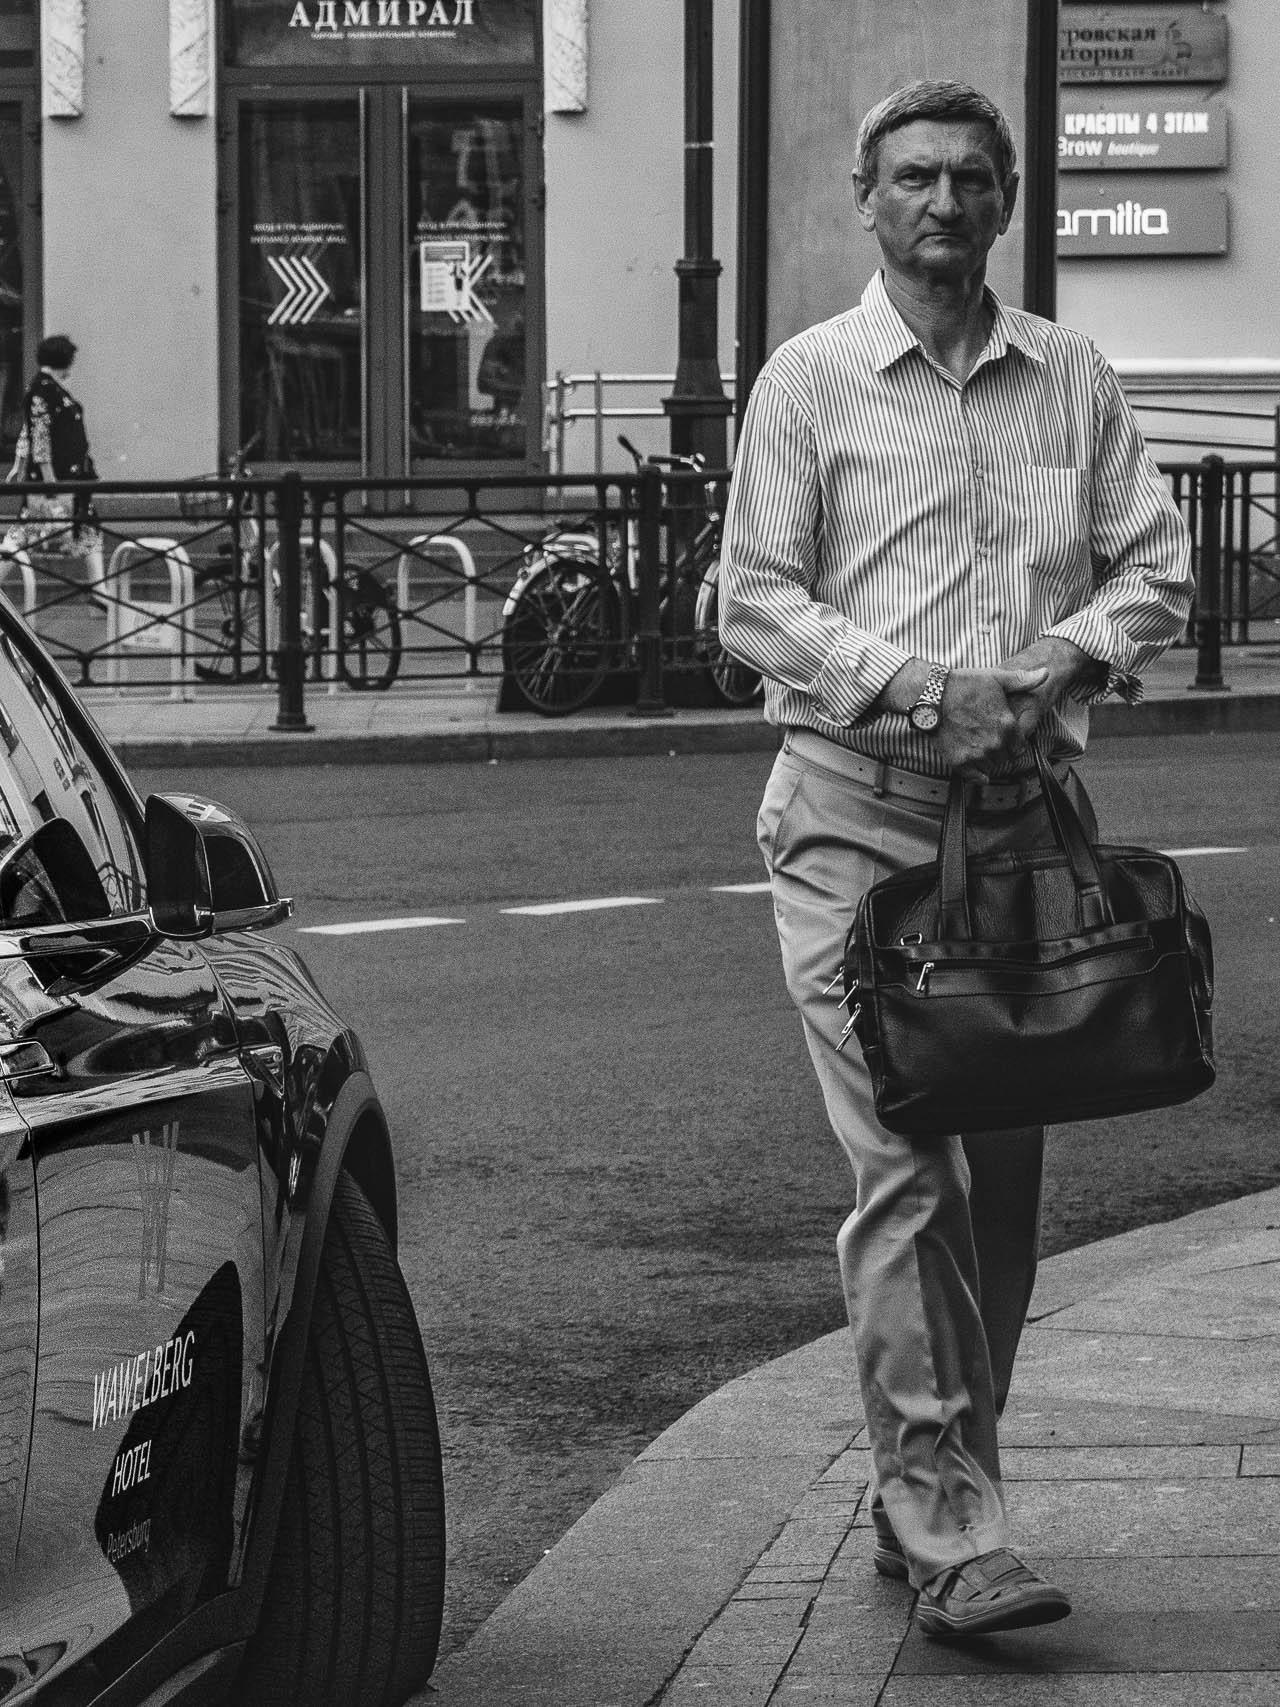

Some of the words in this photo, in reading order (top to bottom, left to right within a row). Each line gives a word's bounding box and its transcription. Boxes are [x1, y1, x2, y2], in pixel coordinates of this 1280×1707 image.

[288, 0, 474, 30] АДМИРАЛ
[1062, 28, 1156, 47] ровская
[1064, 113, 1140, 134] КРАСОТЫ
[1145, 112, 1158, 134] 4
[1164, 112, 1209, 133] ЭТАЖ
[91, 1330, 195, 1432] WAWELBERG
[111, 1439, 153, 1497] HOTEL
[106, 1518, 152, 1562] Petersburg
